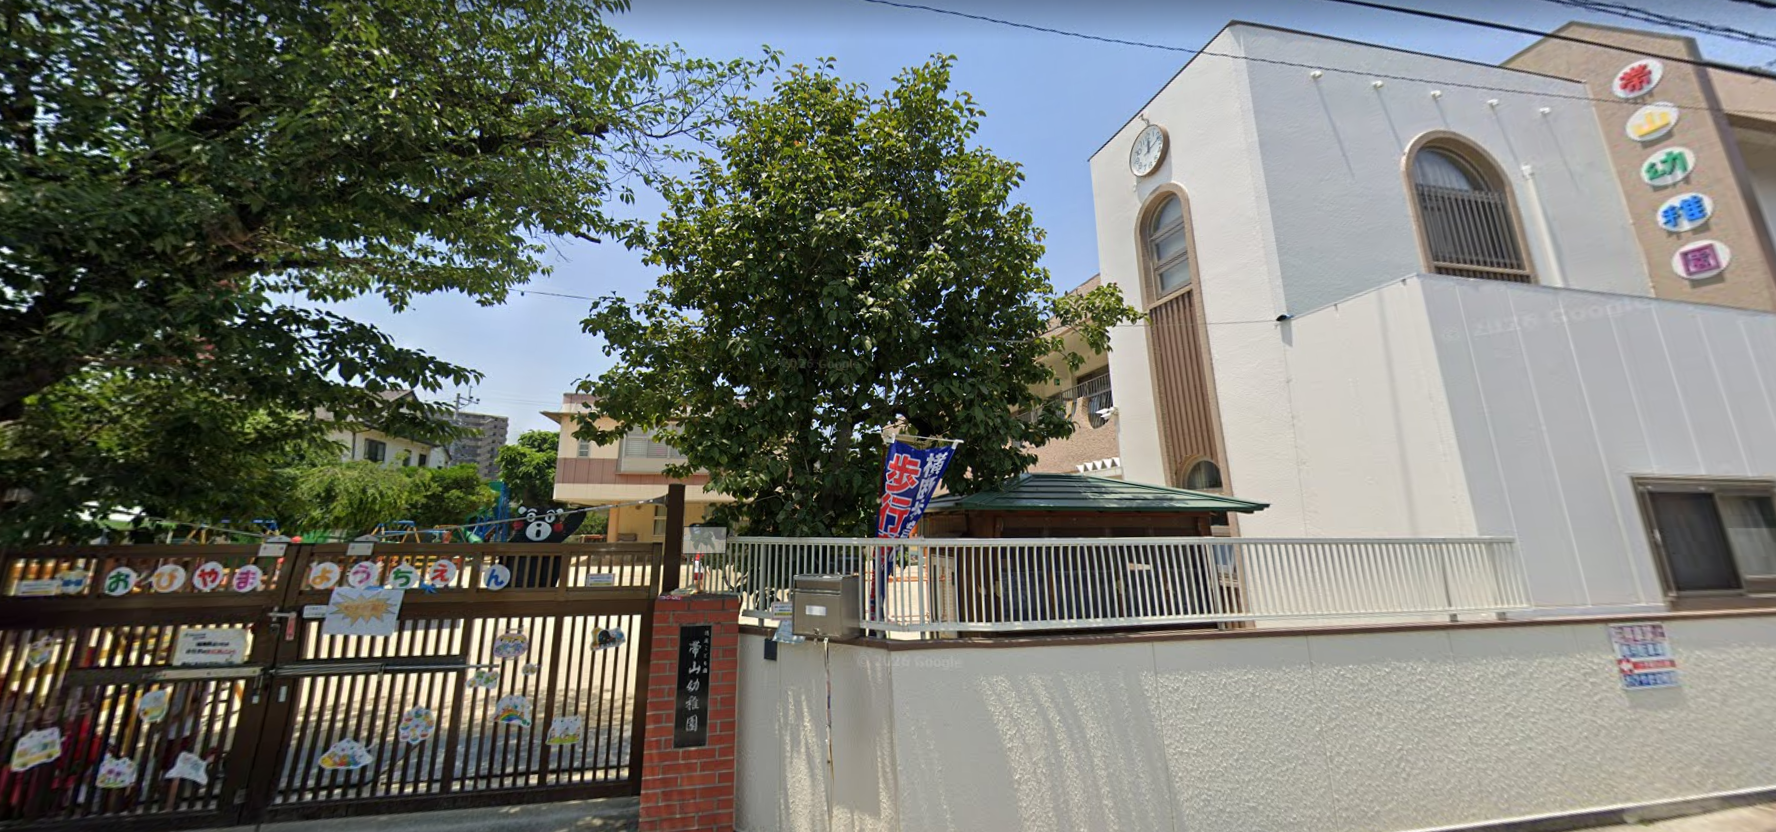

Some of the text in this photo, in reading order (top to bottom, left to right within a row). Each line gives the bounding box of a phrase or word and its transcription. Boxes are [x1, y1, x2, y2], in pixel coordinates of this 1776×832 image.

[1619, 63, 1722, 276] 帯山幼稚園
[878, 453, 922, 538] 歩行
[310, 563, 505, 588] ようちえん
[685, 640, 702, 733] 帯山幼稚園
